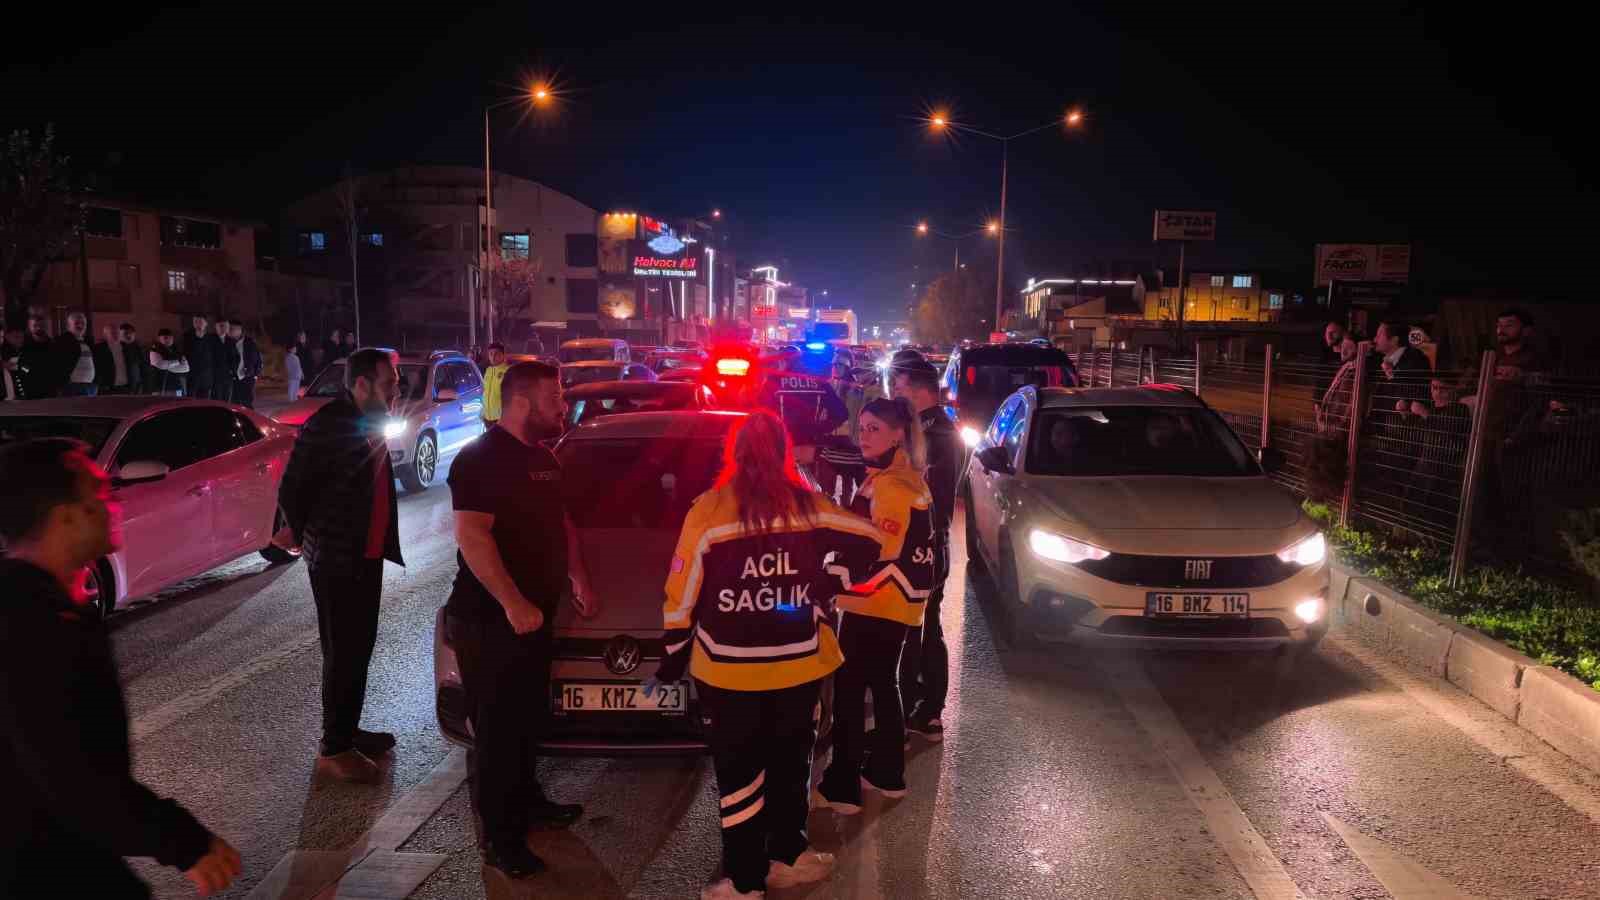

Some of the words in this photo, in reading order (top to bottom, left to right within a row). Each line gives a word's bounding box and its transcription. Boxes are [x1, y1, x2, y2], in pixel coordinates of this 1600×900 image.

[740, 548, 799, 580] ACİL
[1184, 560, 1213, 580] FIAT
[718, 582, 811, 613] SAĞLIK
[1157, 595, 1173, 612] 16
[1183, 596, 1214, 612] BMZ
[1222, 596, 1245, 612] 114
[564, 687, 583, 708] 16
[602, 687, 637, 708] KMZ
[658, 688, 680, 708] 23
